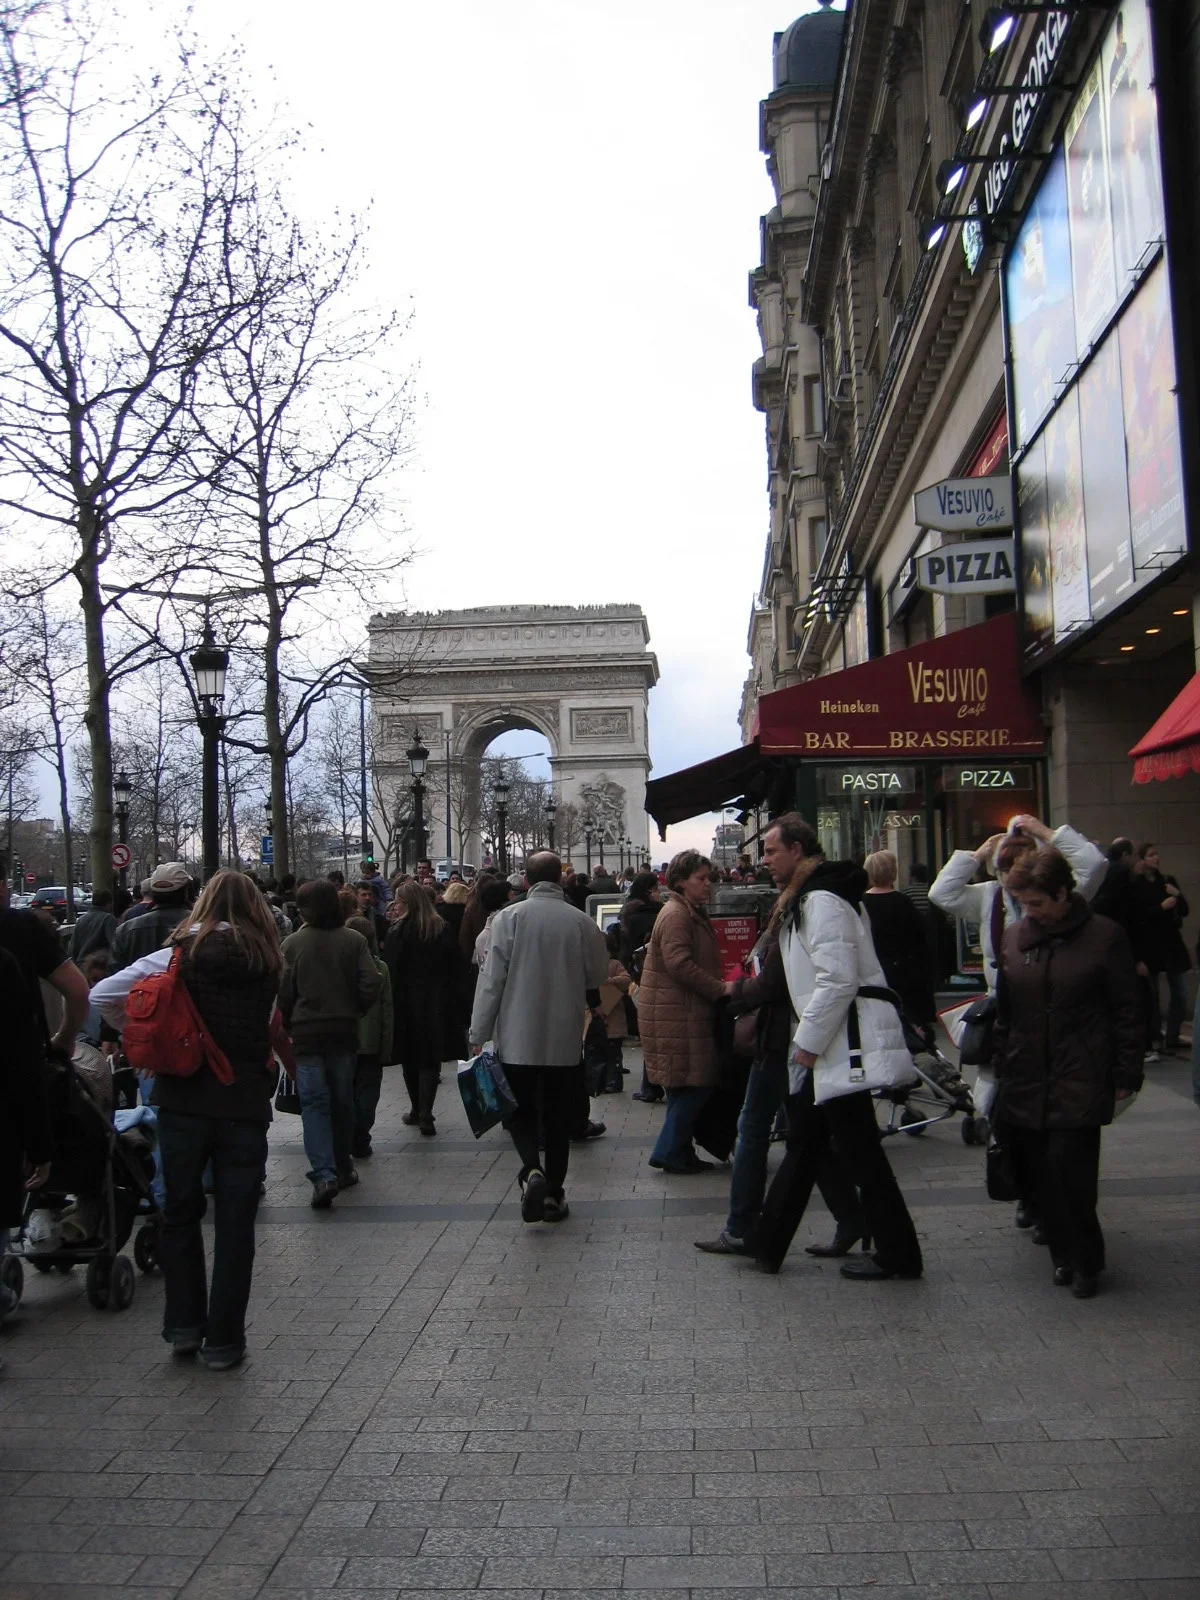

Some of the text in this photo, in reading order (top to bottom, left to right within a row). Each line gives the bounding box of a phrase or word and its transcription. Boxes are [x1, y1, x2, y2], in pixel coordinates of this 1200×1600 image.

[984, 133, 1009, 215] UGC
[936, 485, 994, 515] VESUVIO
[976, 506, 1006, 527] Café
[927, 551, 1013, 585] PIZZA
[907, 661, 988, 703] VESUVIO
[820, 699, 880, 714] Heineken
[957, 702, 987, 718] Café
[804, 728, 1010, 749] BAR BRASSERIE
[842, 773, 901, 790] PASTA
[961, 770, 1015, 787] PIZZA
